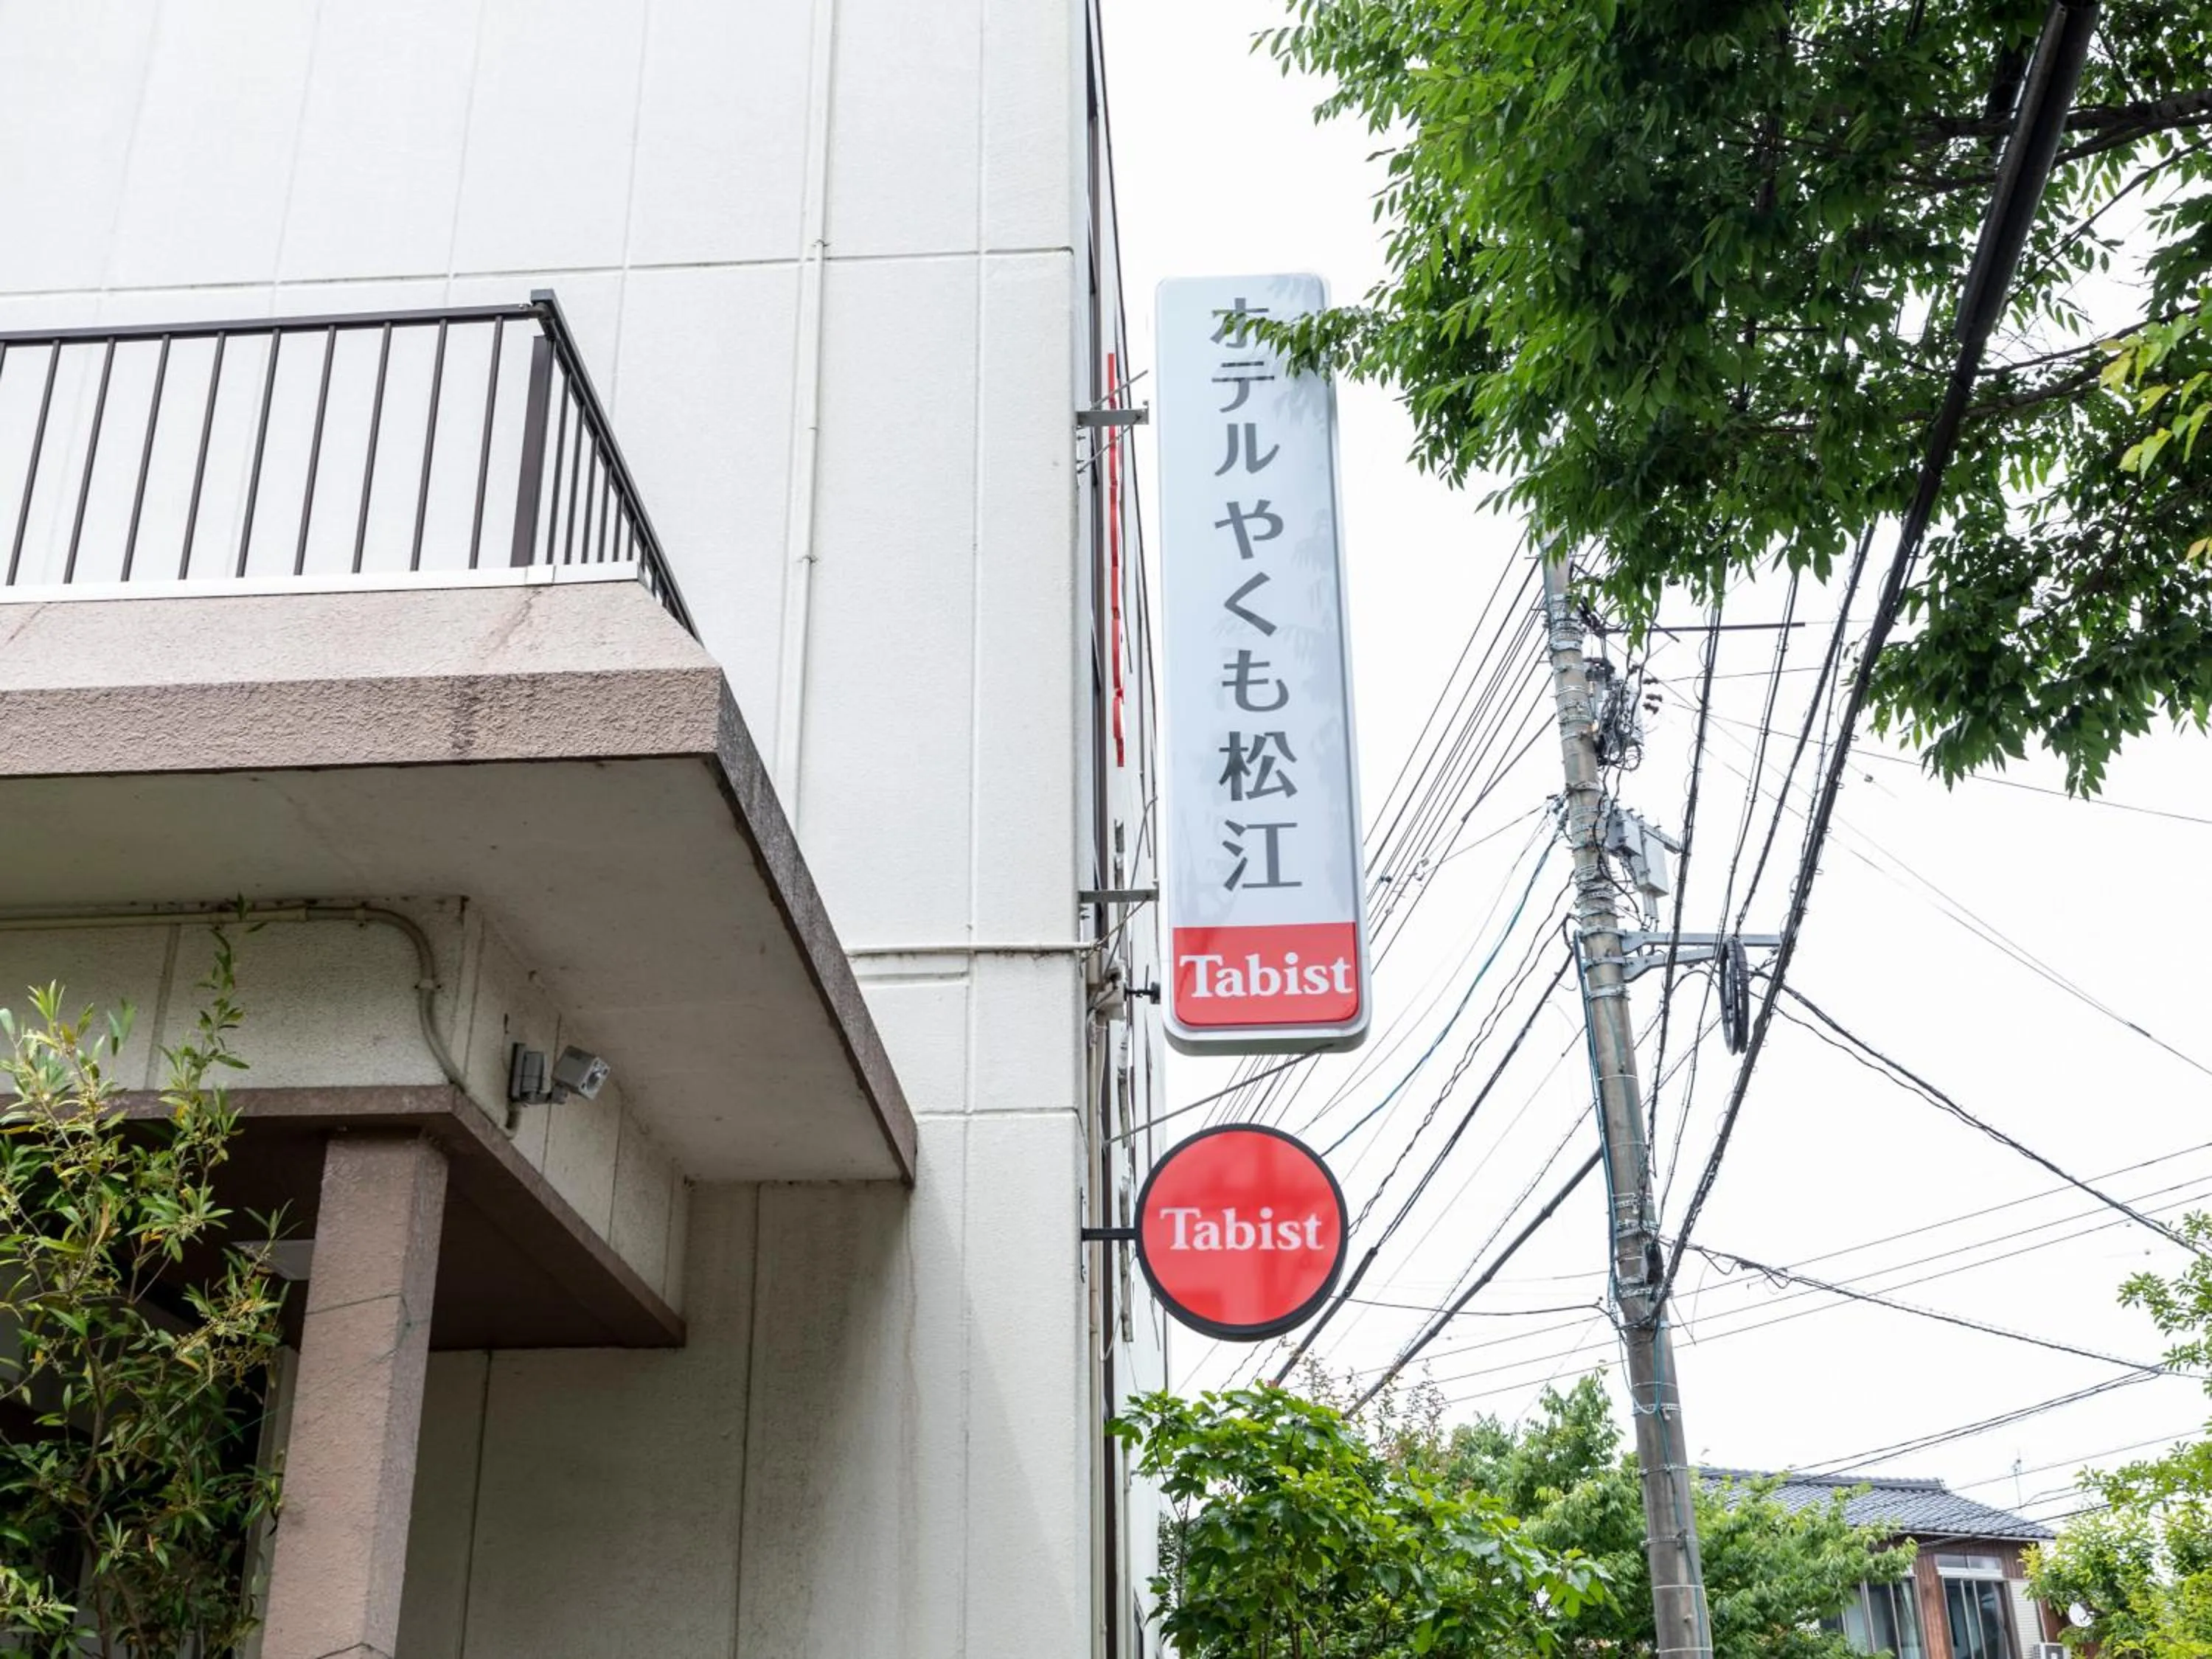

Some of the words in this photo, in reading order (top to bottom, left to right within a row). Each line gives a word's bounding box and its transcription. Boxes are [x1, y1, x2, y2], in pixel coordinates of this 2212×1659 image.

[1210, 298, 1302, 891] ホテルやくも松江
[1180, 952, 1353, 998] Tabist
[1160, 1206, 1324, 1251] Tabist
